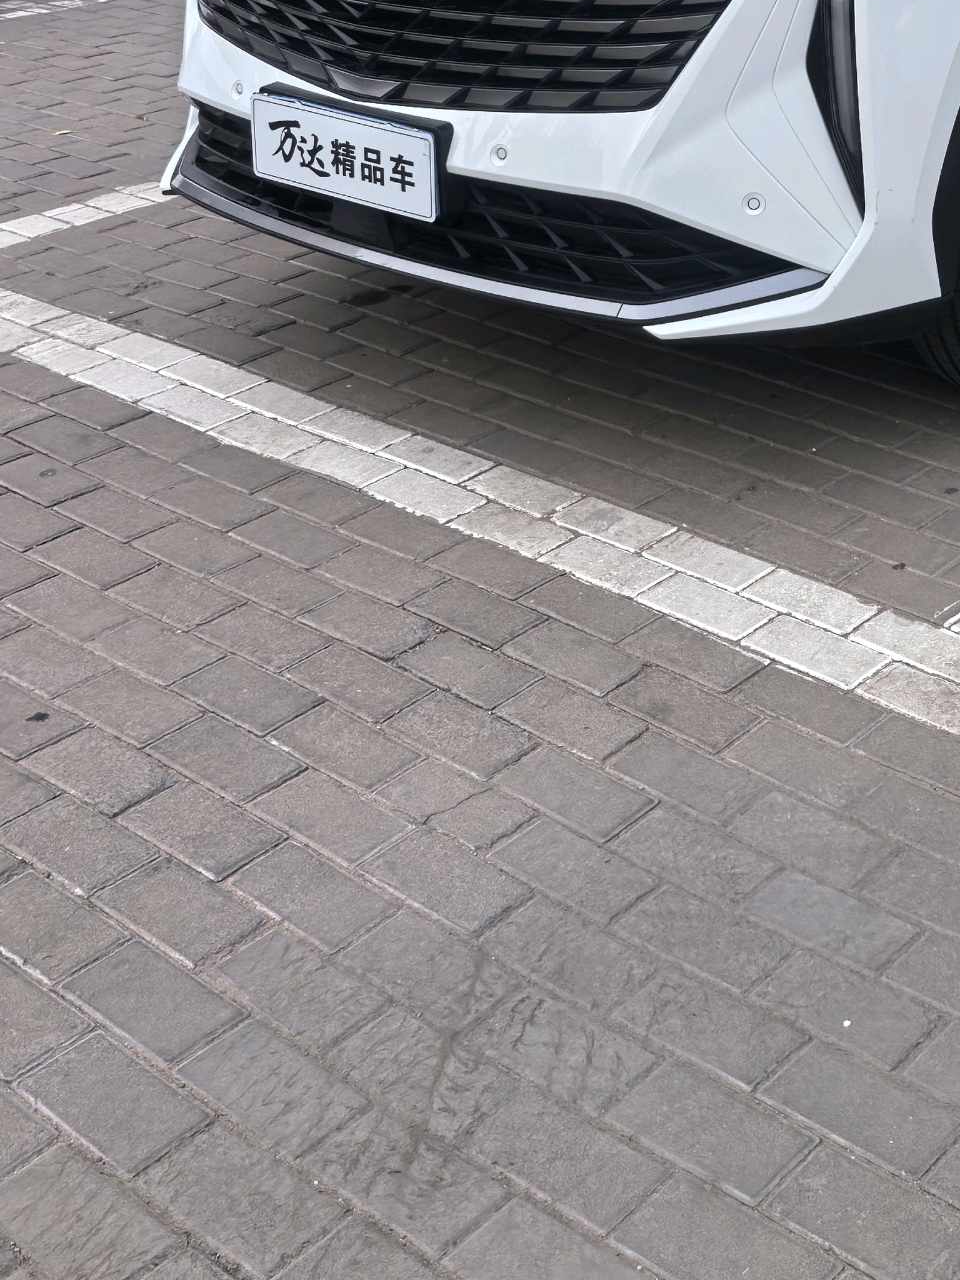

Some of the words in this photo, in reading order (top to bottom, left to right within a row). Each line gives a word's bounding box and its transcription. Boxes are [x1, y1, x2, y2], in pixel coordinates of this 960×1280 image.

[268, 119, 416, 193] 万达精品车
